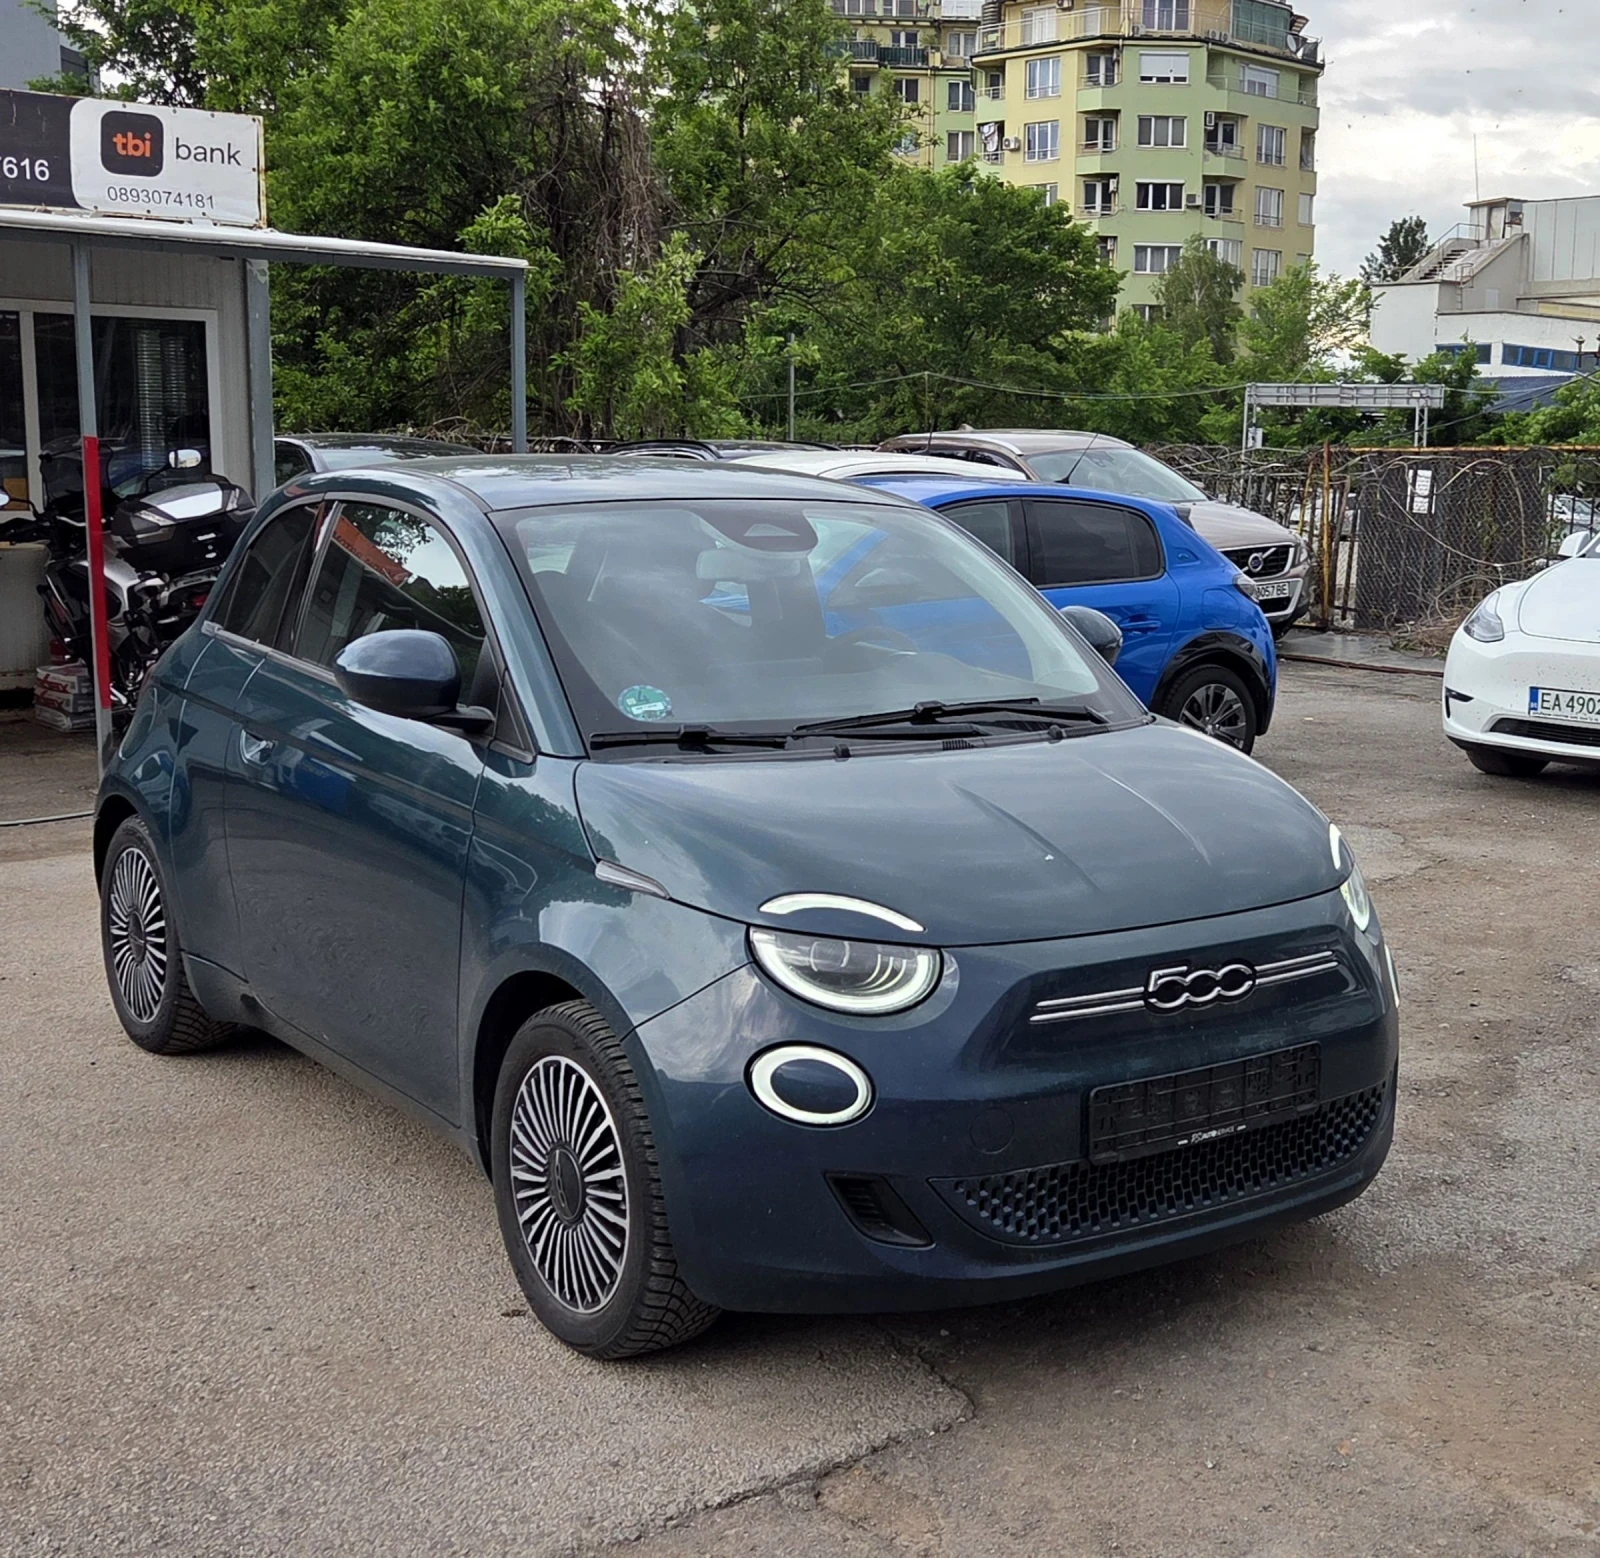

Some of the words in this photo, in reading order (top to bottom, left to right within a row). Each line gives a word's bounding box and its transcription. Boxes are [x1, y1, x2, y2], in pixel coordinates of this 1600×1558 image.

[113, 132, 152, 157] tbi
[176, 137, 242, 166] bank
[0, 156, 49, 181] 616
[107, 186, 215, 209] 0893074181
[1541, 692, 1561, 711] EA
[1148, 964, 1253, 1009] 500
